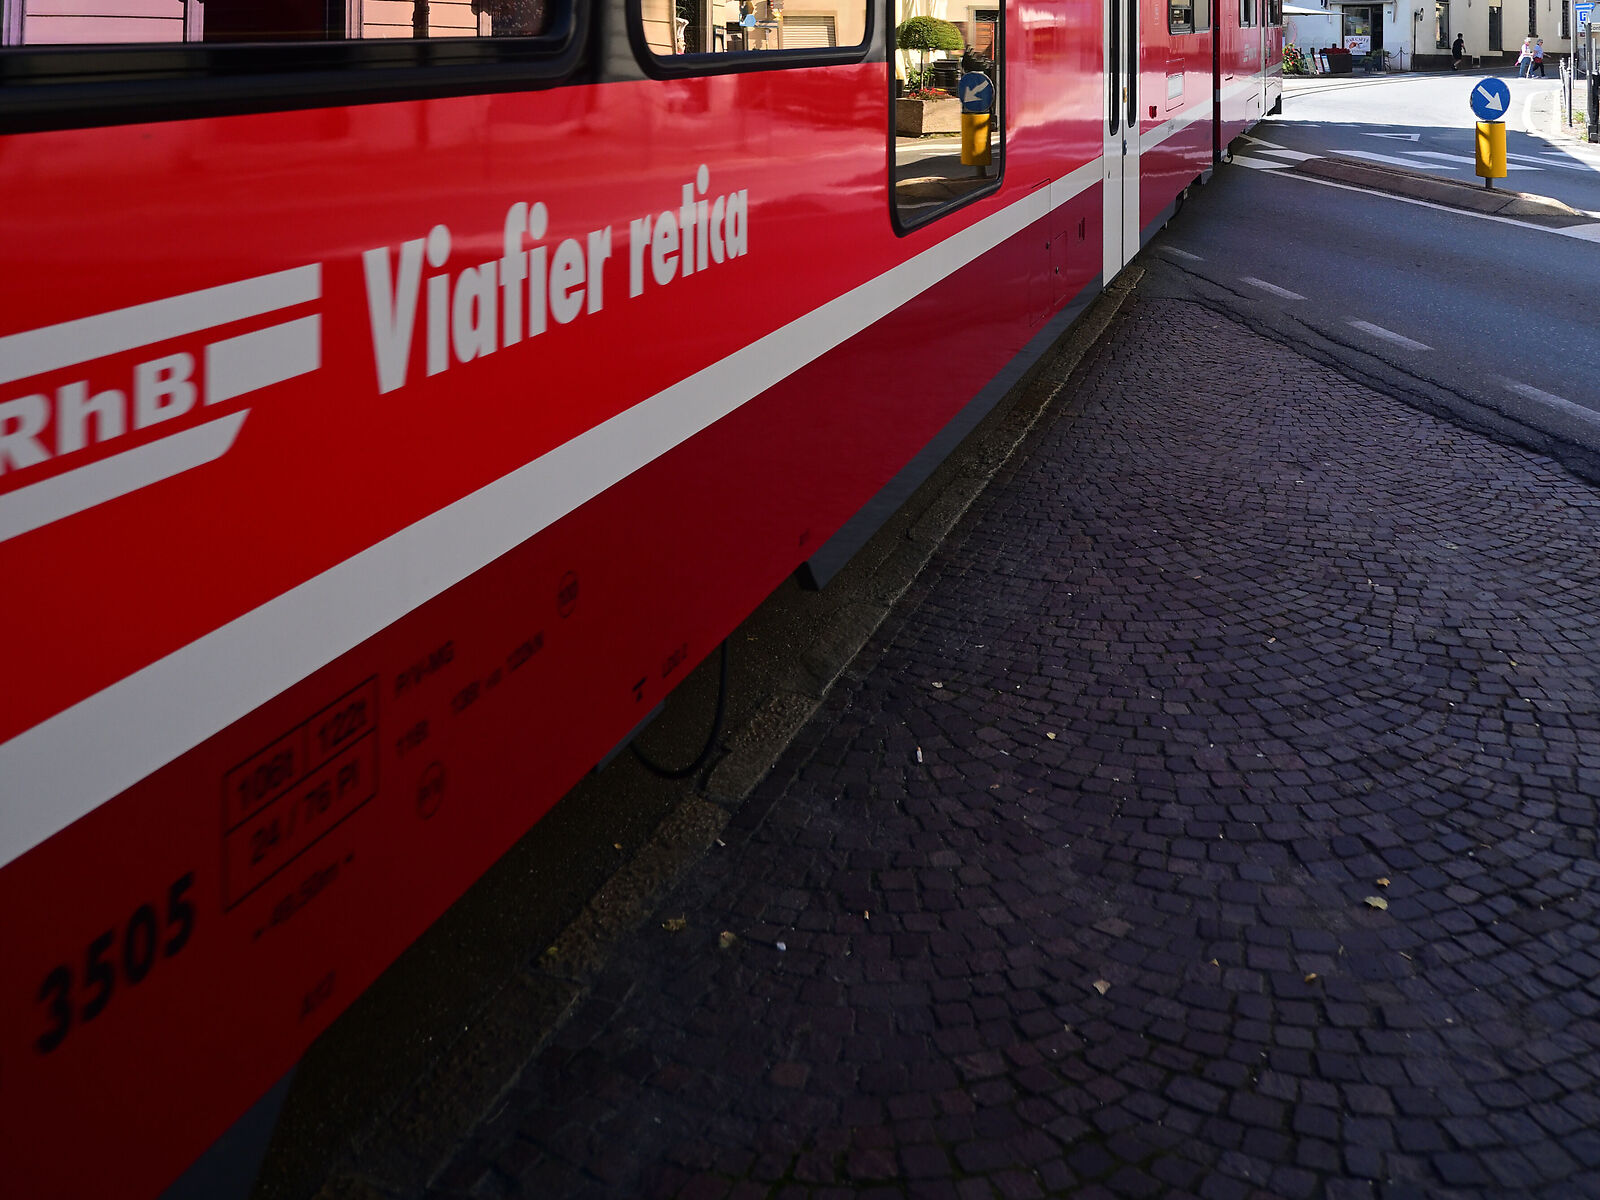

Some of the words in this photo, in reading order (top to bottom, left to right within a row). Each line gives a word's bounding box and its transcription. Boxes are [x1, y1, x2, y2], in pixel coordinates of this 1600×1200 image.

[362, 201, 612, 395] Viafier
[629, 163, 748, 298] retica
[0, 351, 198, 477] RhB
[33, 870, 198, 1056] 3505
